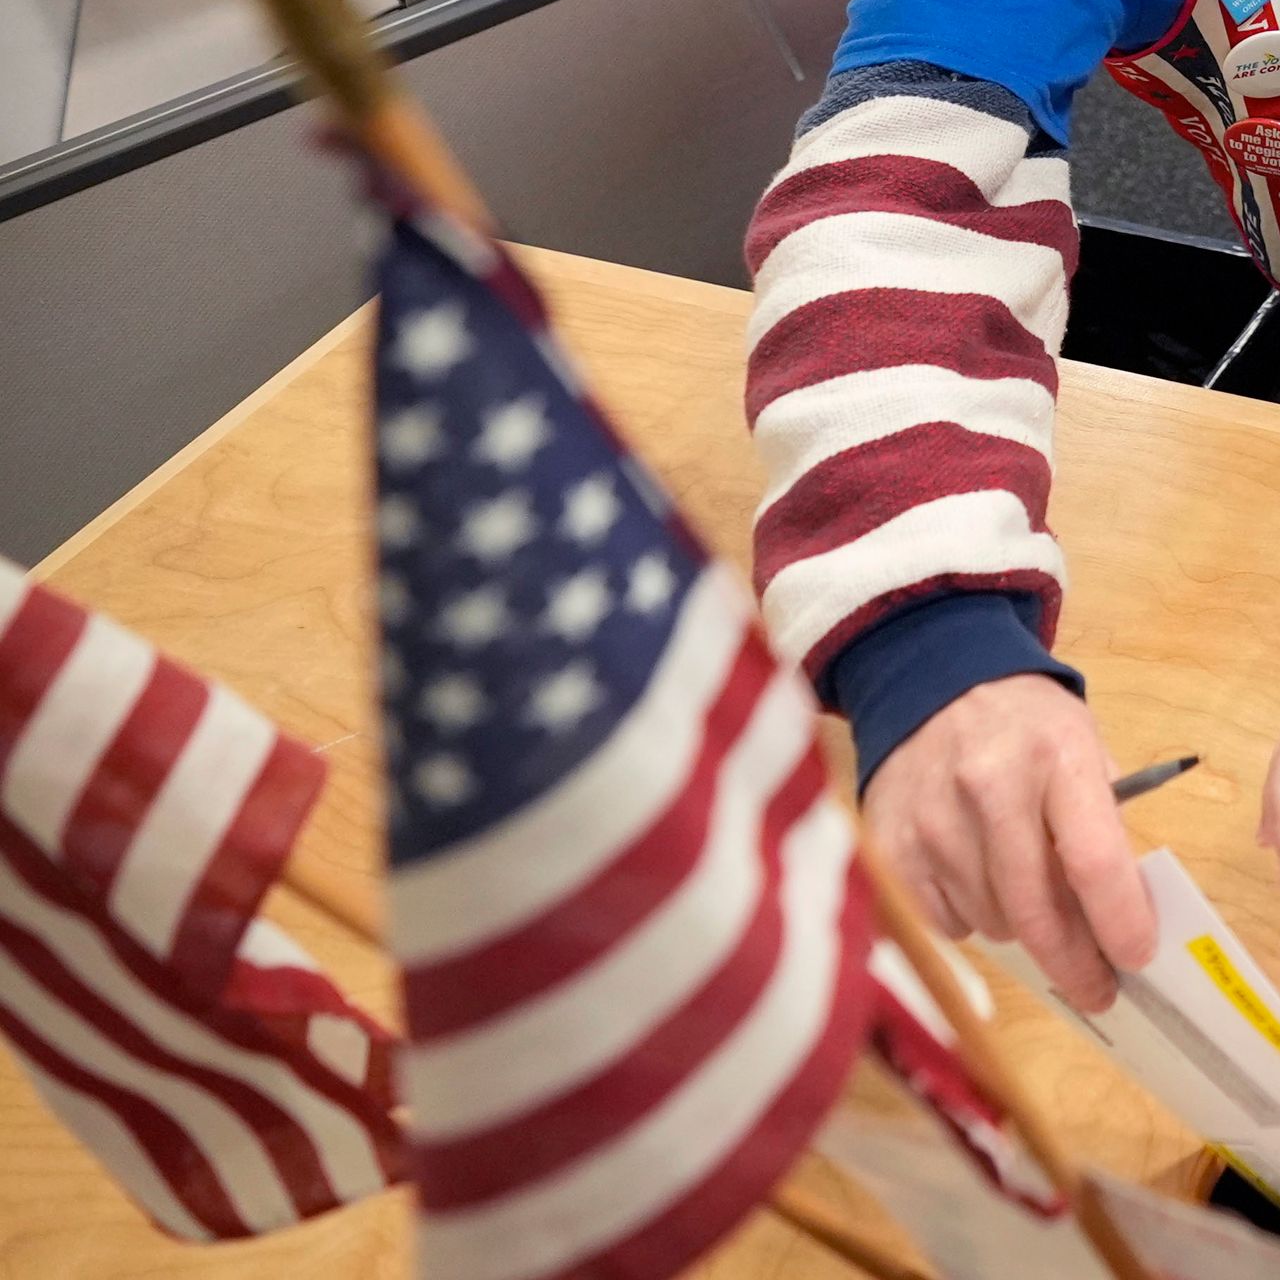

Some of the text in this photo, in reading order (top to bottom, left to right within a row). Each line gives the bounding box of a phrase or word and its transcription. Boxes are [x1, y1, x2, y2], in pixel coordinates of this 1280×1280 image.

[1235, 62, 1259, 73] THE
[1232, 69, 1257, 81] ARE
[1255, 125, 1280, 140] Ask
[1229, 139, 1243, 151] to
[1240, 133, 1263, 145] me
[1243, 150, 1258, 163] to
